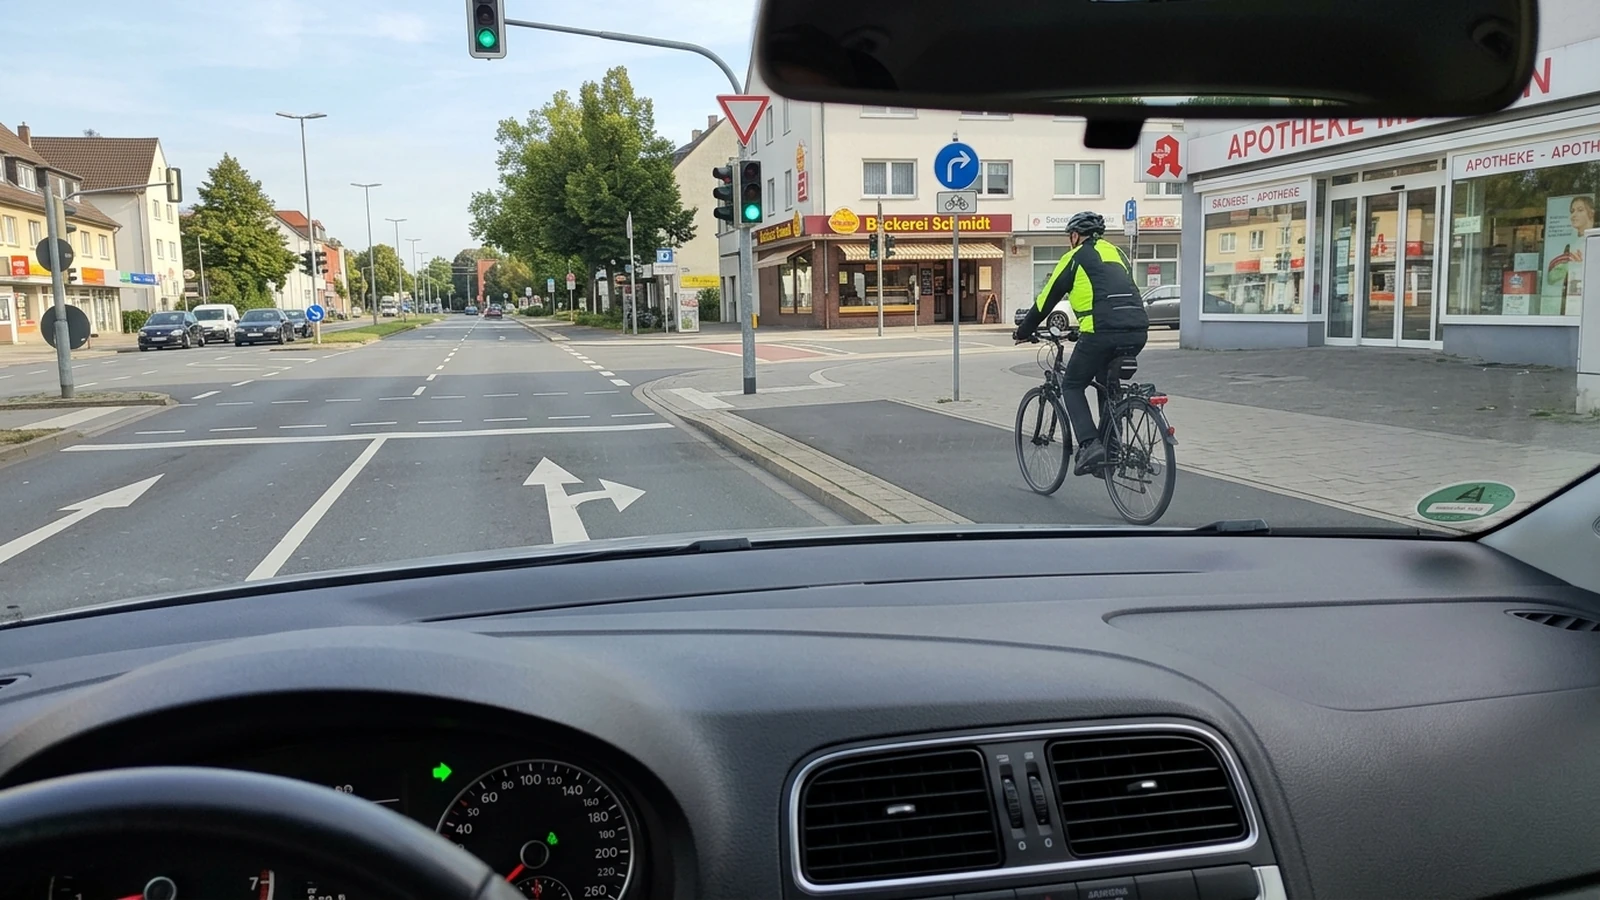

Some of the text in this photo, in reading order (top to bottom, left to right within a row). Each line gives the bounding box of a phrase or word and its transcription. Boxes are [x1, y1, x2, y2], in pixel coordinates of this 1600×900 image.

[1228, 118, 1364, 160] APOTHEKE
[1465, 149, 1534, 172] APOTHEKE
[866, 217, 929, 231] Bckerei
[501, 781, 514, 790] 80
[520, 774, 542, 786] 100
[546, 777, 563, 786] 120
[562, 785, 583, 796] 140
[481, 792, 498, 804] 60
[583, 798, 599, 807] 160
[467, 808, 480, 817] 50
[588, 811, 609, 823] 180
[455, 823, 472, 835] 40
[595, 847, 618, 859] 200
[597, 868, 615, 877] 220
[249, 876, 258, 891] 7
[584, 885, 607, 897] 260
